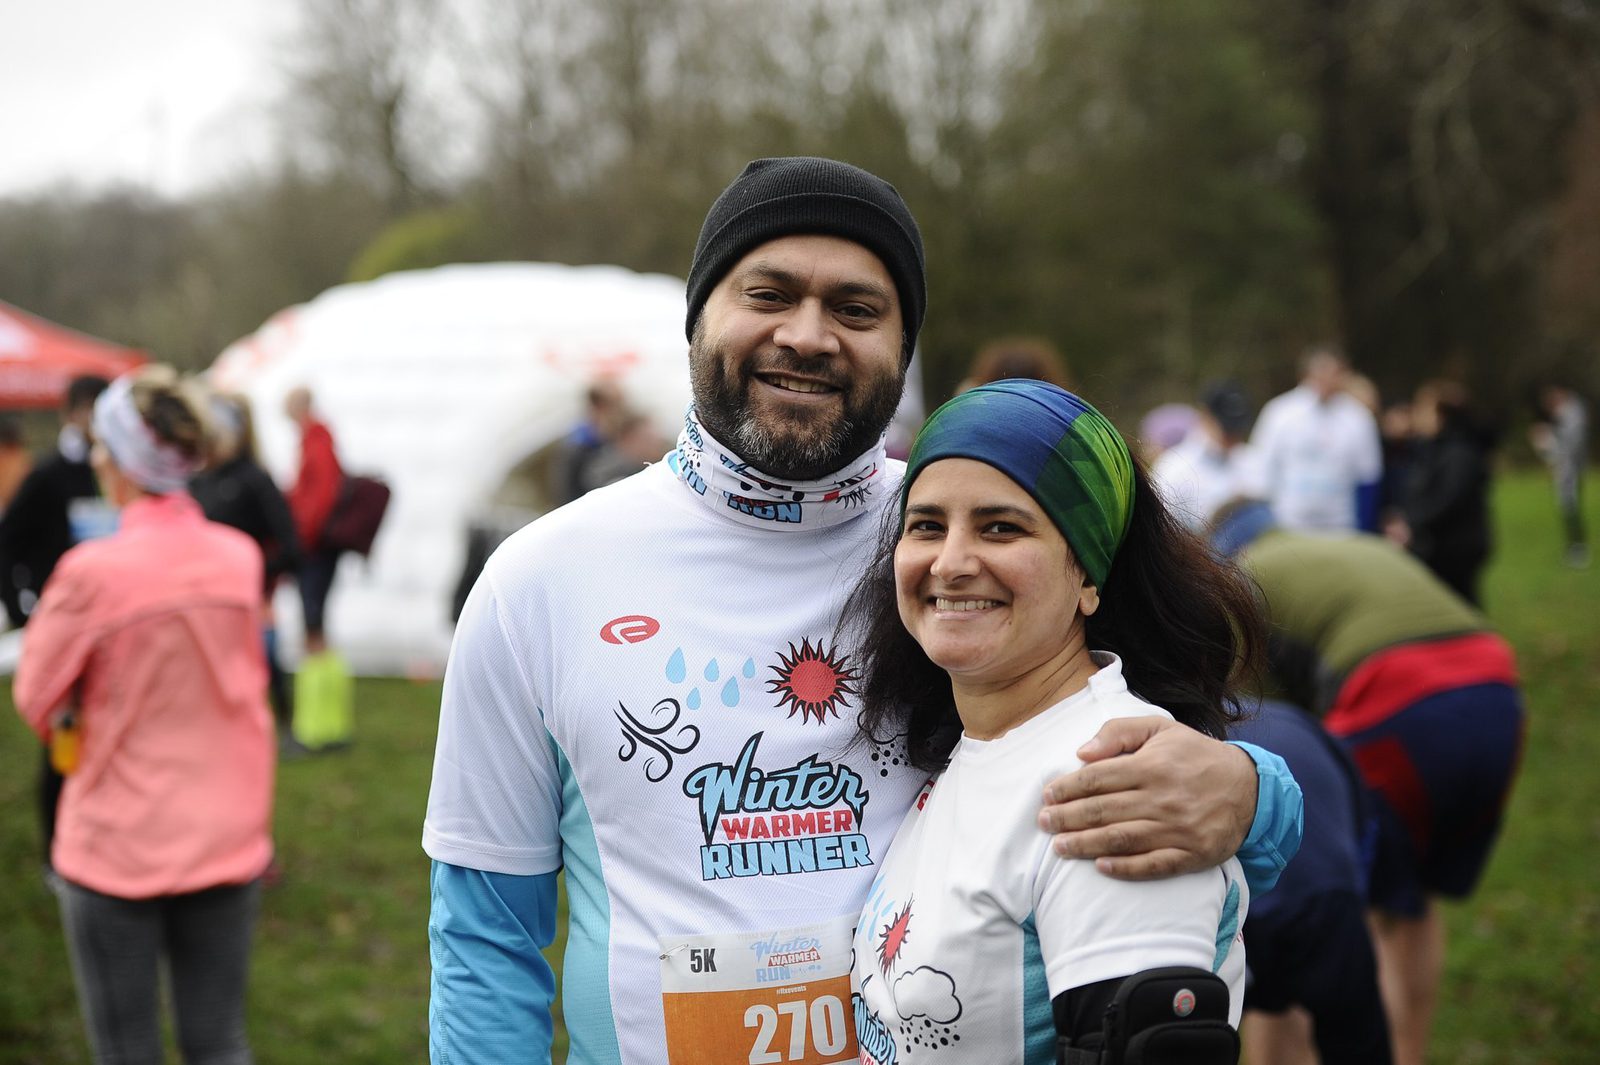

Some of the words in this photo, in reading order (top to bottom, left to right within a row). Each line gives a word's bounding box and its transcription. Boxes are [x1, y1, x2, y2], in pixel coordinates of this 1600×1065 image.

[682, 731, 870, 844] Winter
[721, 810, 853, 840] WARMER
[700, 833, 874, 881] RUNNER
[690, 948, 717, 973] 5K
[749, 931, 823, 962] Winter
[769, 949, 819, 967] WARMER
[756, 966, 791, 983] RUN
[743, 994, 847, 1065] 270
